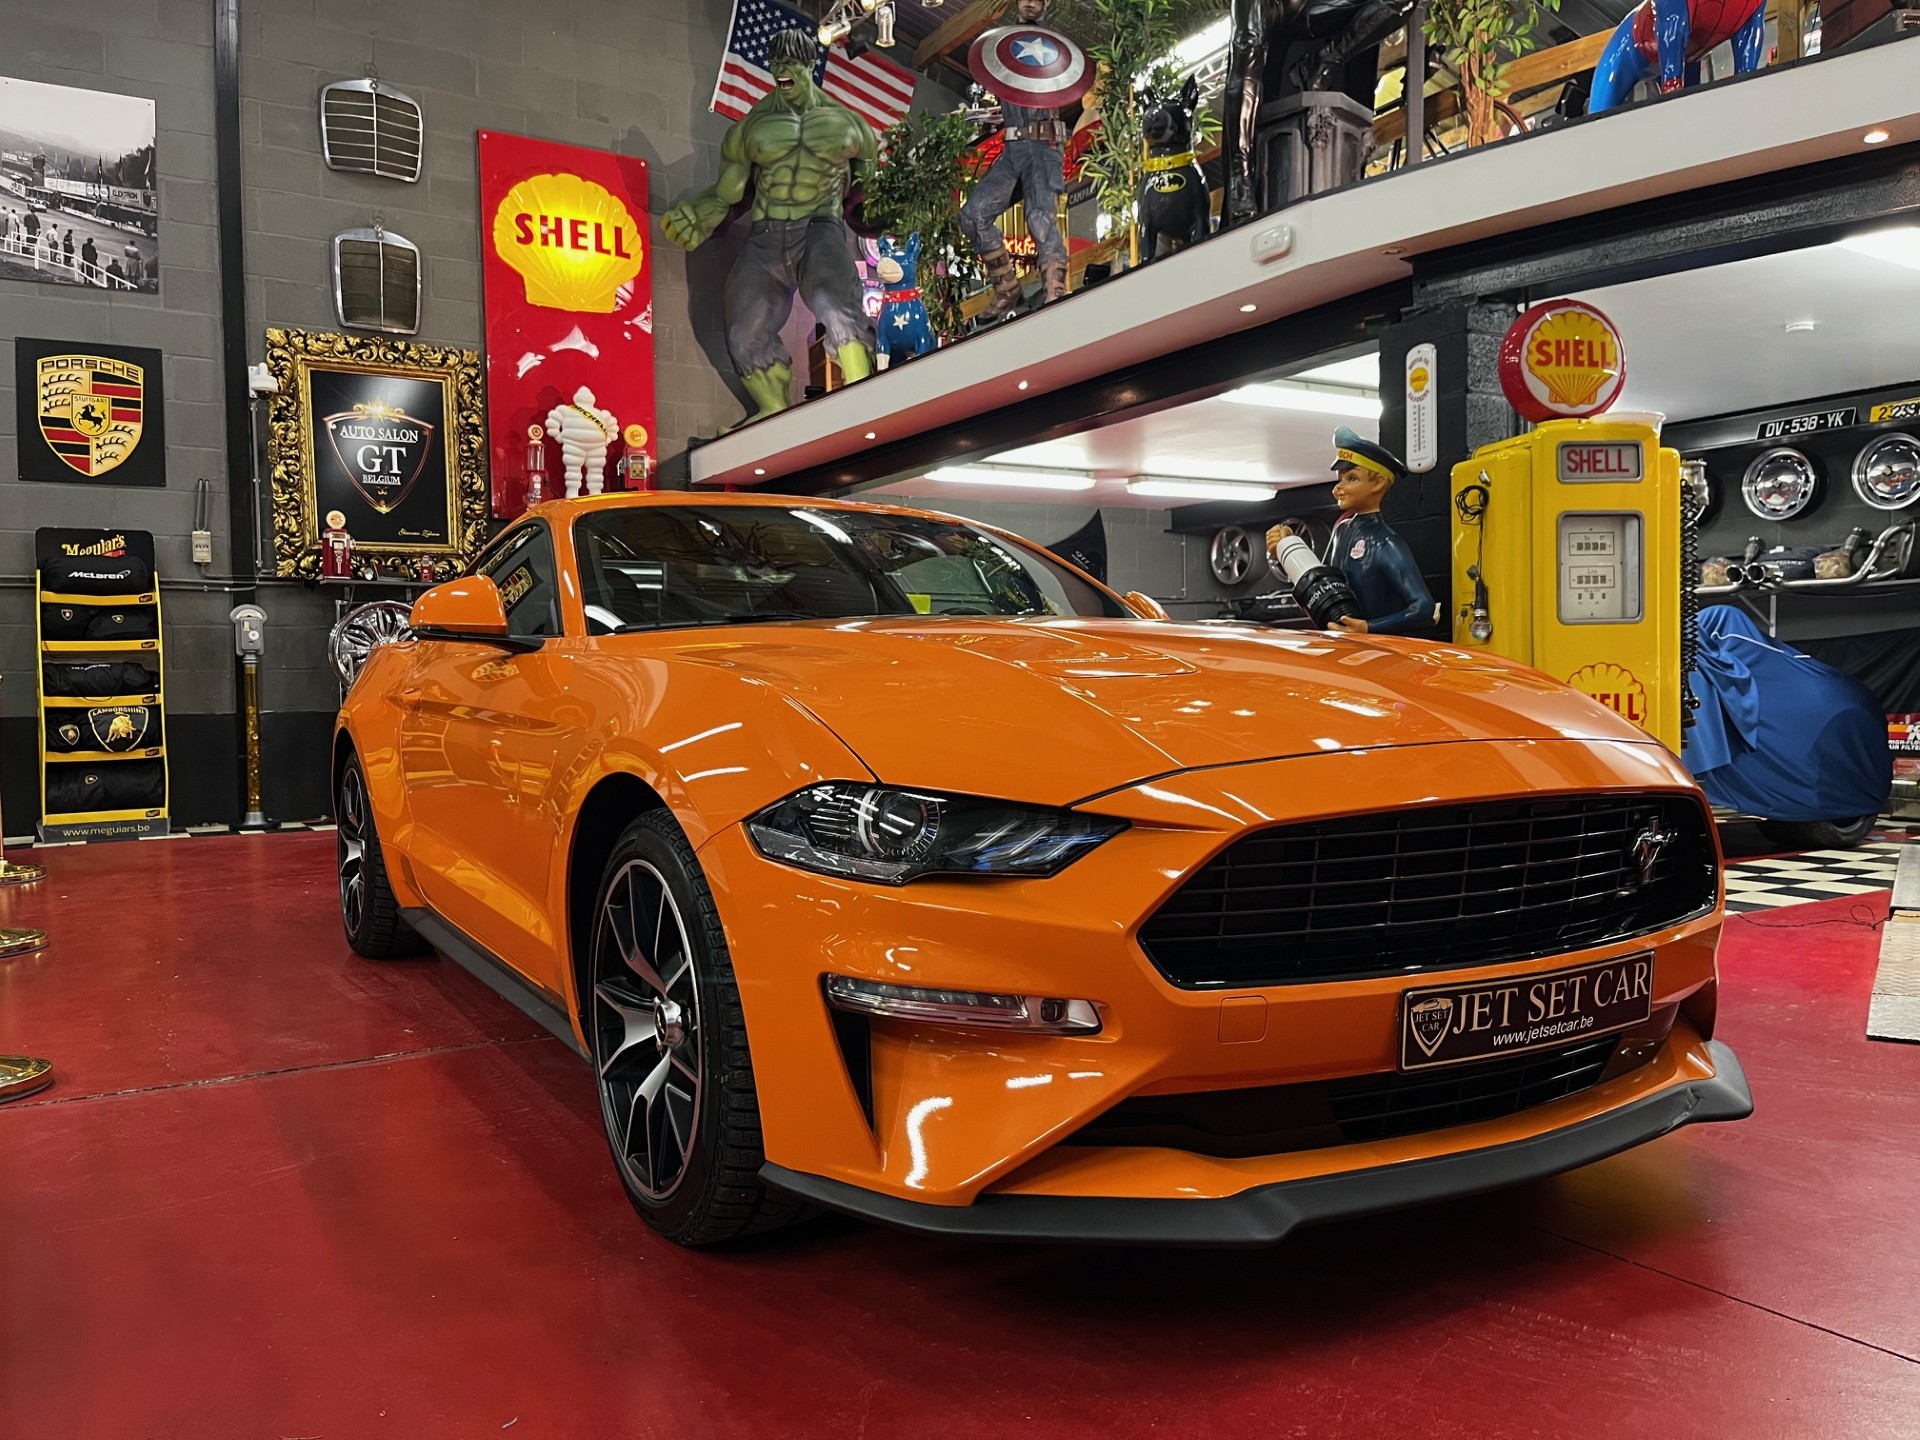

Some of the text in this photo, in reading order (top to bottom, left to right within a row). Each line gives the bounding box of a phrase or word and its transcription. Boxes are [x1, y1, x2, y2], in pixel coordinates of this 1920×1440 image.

[514, 213, 631, 260] SHELL
[1535, 339, 1612, 368] SHELL
[41, 358, 139, 380] PORSCHE
[340, 425, 419, 442] AUTO SALON
[1765, 411, 1845, 437] DV-538-YK
[356, 444, 407, 474] GT
[1567, 449, 1630, 473] SHELL
[362, 474, 401, 485] BELGIUM
[67, 570, 126, 580] McLaren
[91, 706, 145, 716] LAMBORGHINI
[62, 823, 150, 837] www.meguiars.be
[1453, 962, 1649, 1035] JET SET CAR
[1414, 1009, 1448, 1023] JET SET
[1421, 1022, 1440, 1032] CAR
[1492, 1014, 1594, 1047] www.jetsetcar.be
